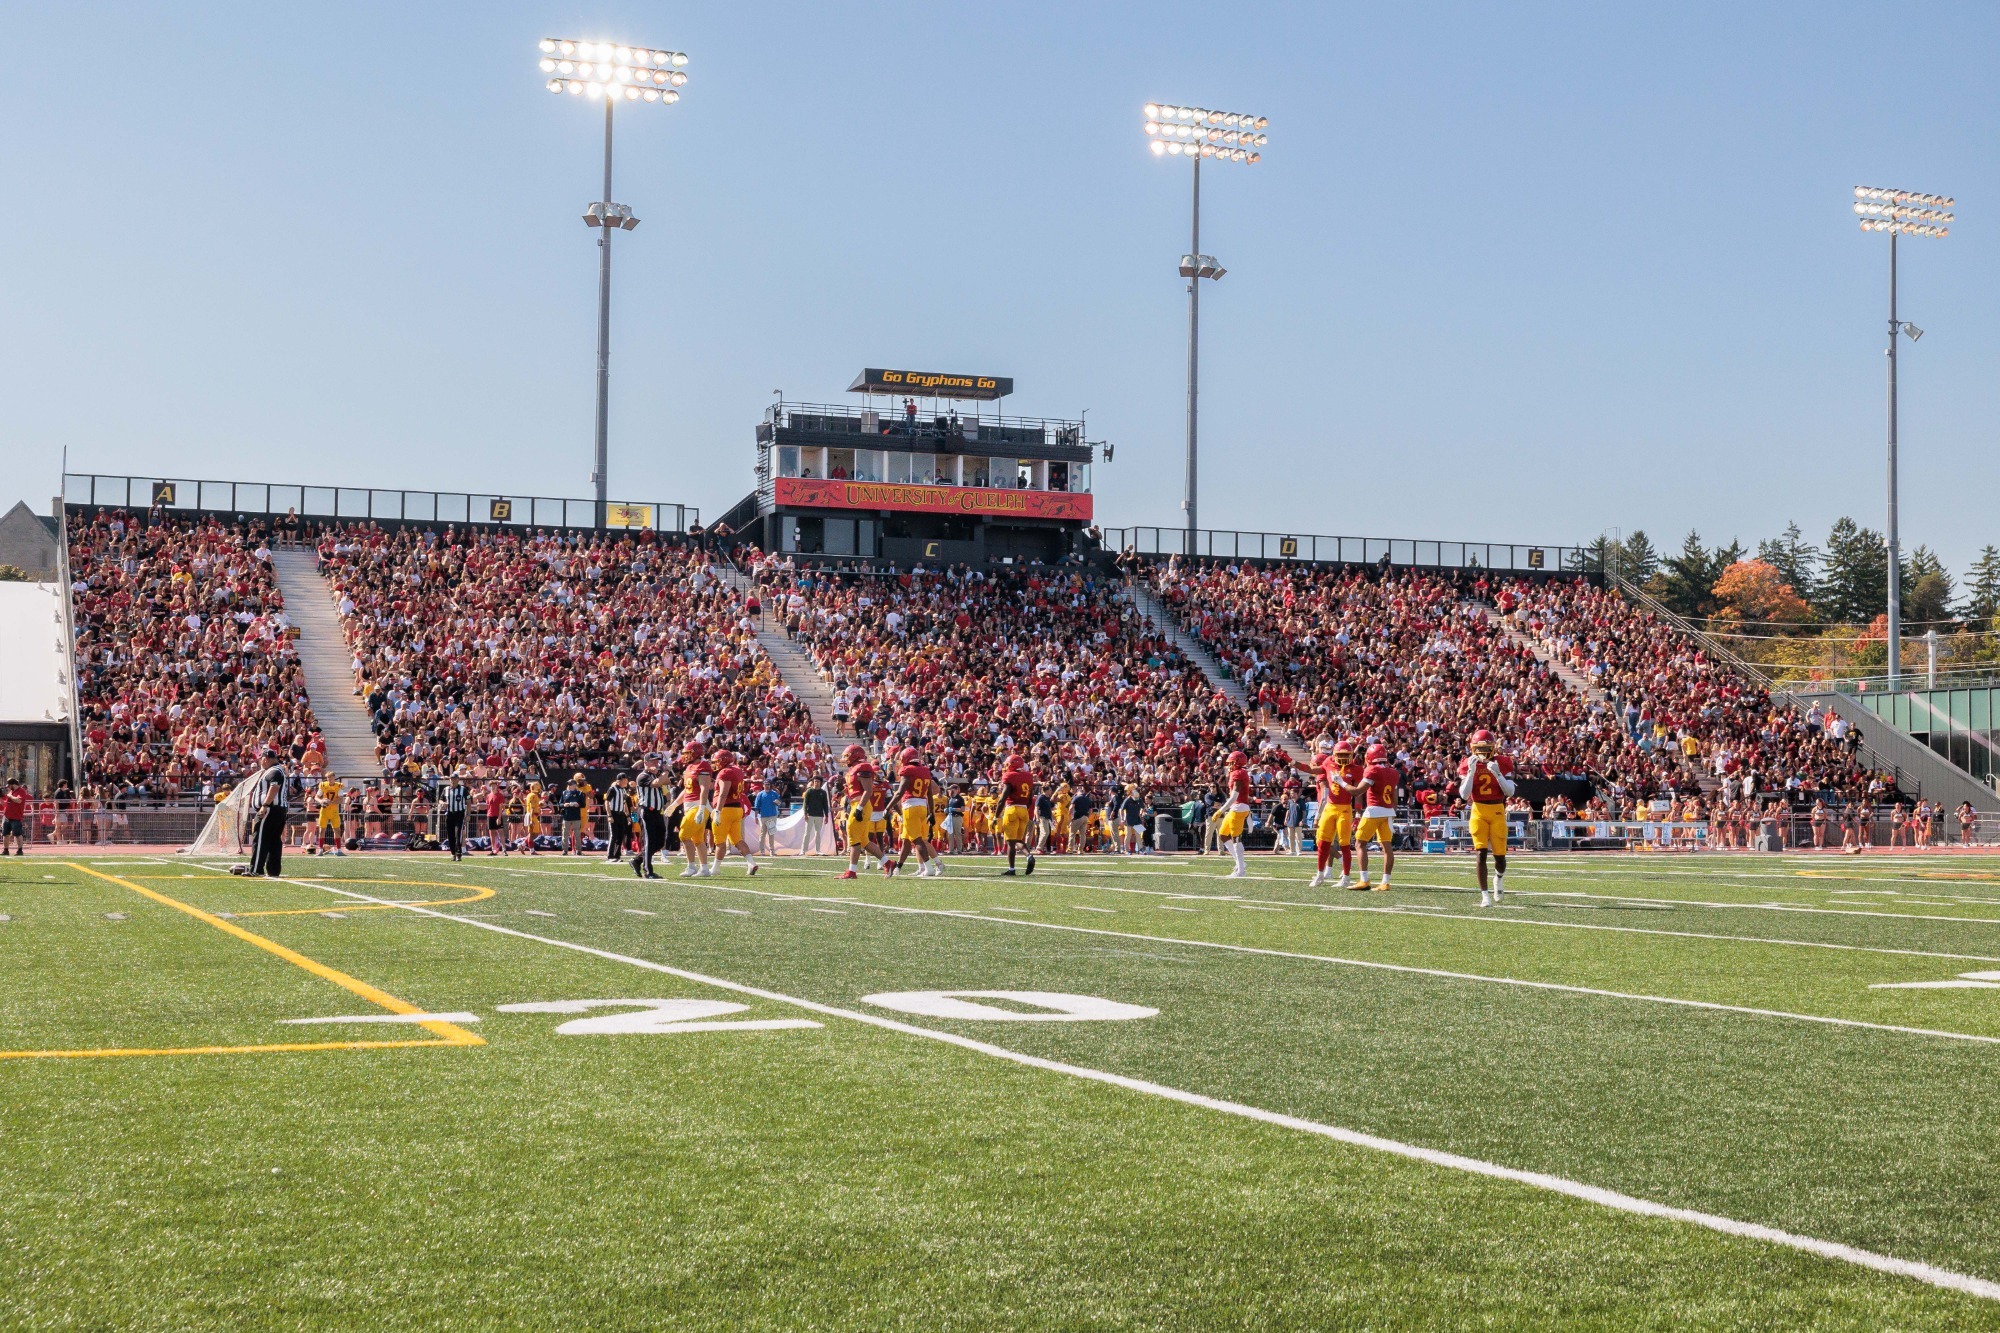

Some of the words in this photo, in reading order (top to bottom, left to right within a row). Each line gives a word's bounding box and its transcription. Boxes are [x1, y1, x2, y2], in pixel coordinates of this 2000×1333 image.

[882, 370, 902, 382] Go
[905, 372, 974, 387] Gryphons
[976, 377, 996, 389] Go
[155, 486, 173, 502] A
[845, 484, 950, 506] UNIVERSITY
[960, 490, 1027, 512] GUELPH
[492, 502, 509, 518] B
[925, 542, 939, 557] C
[1282, 540, 1296, 554] D
[1530, 552, 1542, 565] E
[911, 778, 931, 798] 97
[1020, 782, 1030, 798] 9
[1478, 773, 1493, 795] 2
[873, 791, 882, 807] 7
[1382, 784, 1392, 805] 6
